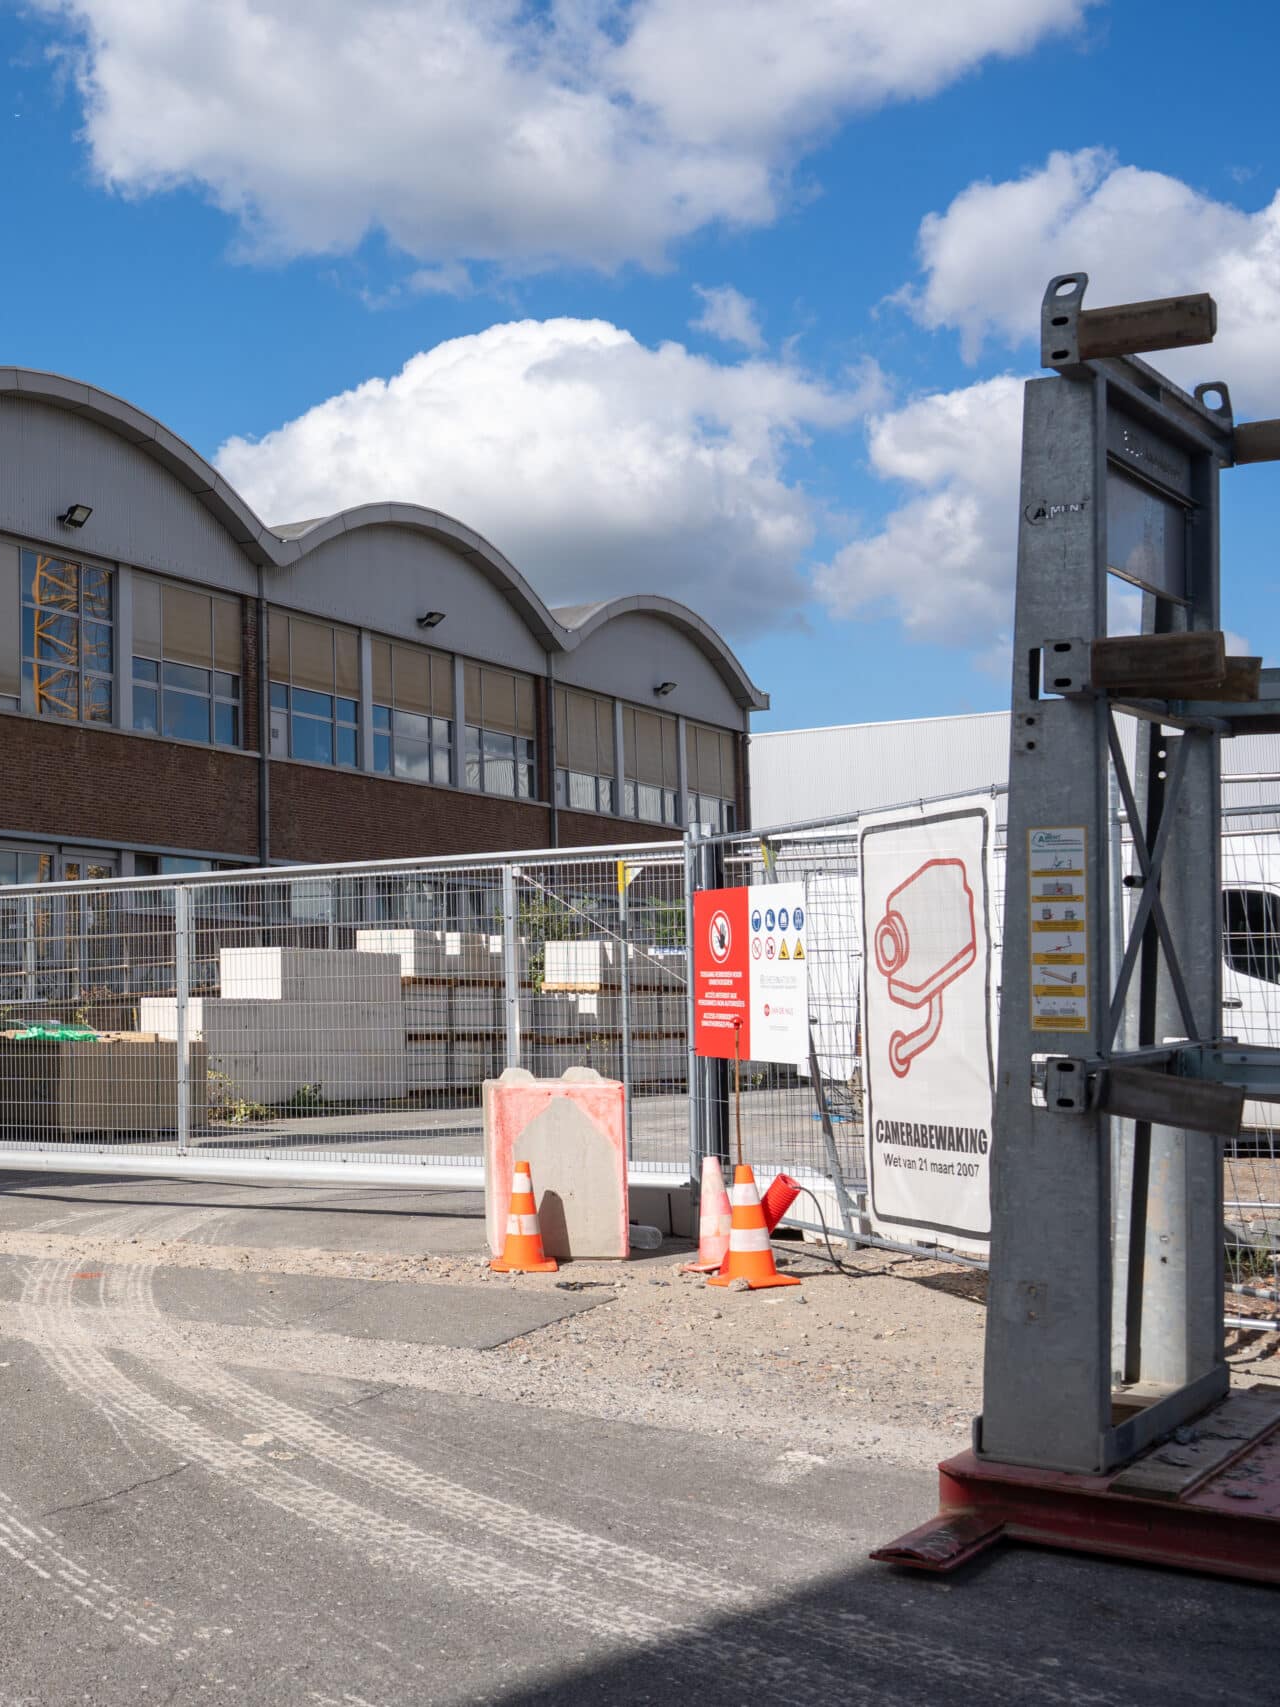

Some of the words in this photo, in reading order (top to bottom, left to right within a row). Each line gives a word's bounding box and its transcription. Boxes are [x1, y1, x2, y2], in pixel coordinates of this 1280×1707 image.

[876, 1120, 988, 1155] CAMERABEWAKING
[883, 1153, 902, 1168] Wet
[902, 1159, 917, 1169] van
[918, 1158, 928, 1172] 21
[930, 1162, 955, 1176] maart
[957, 1163, 980, 1177] 2007
